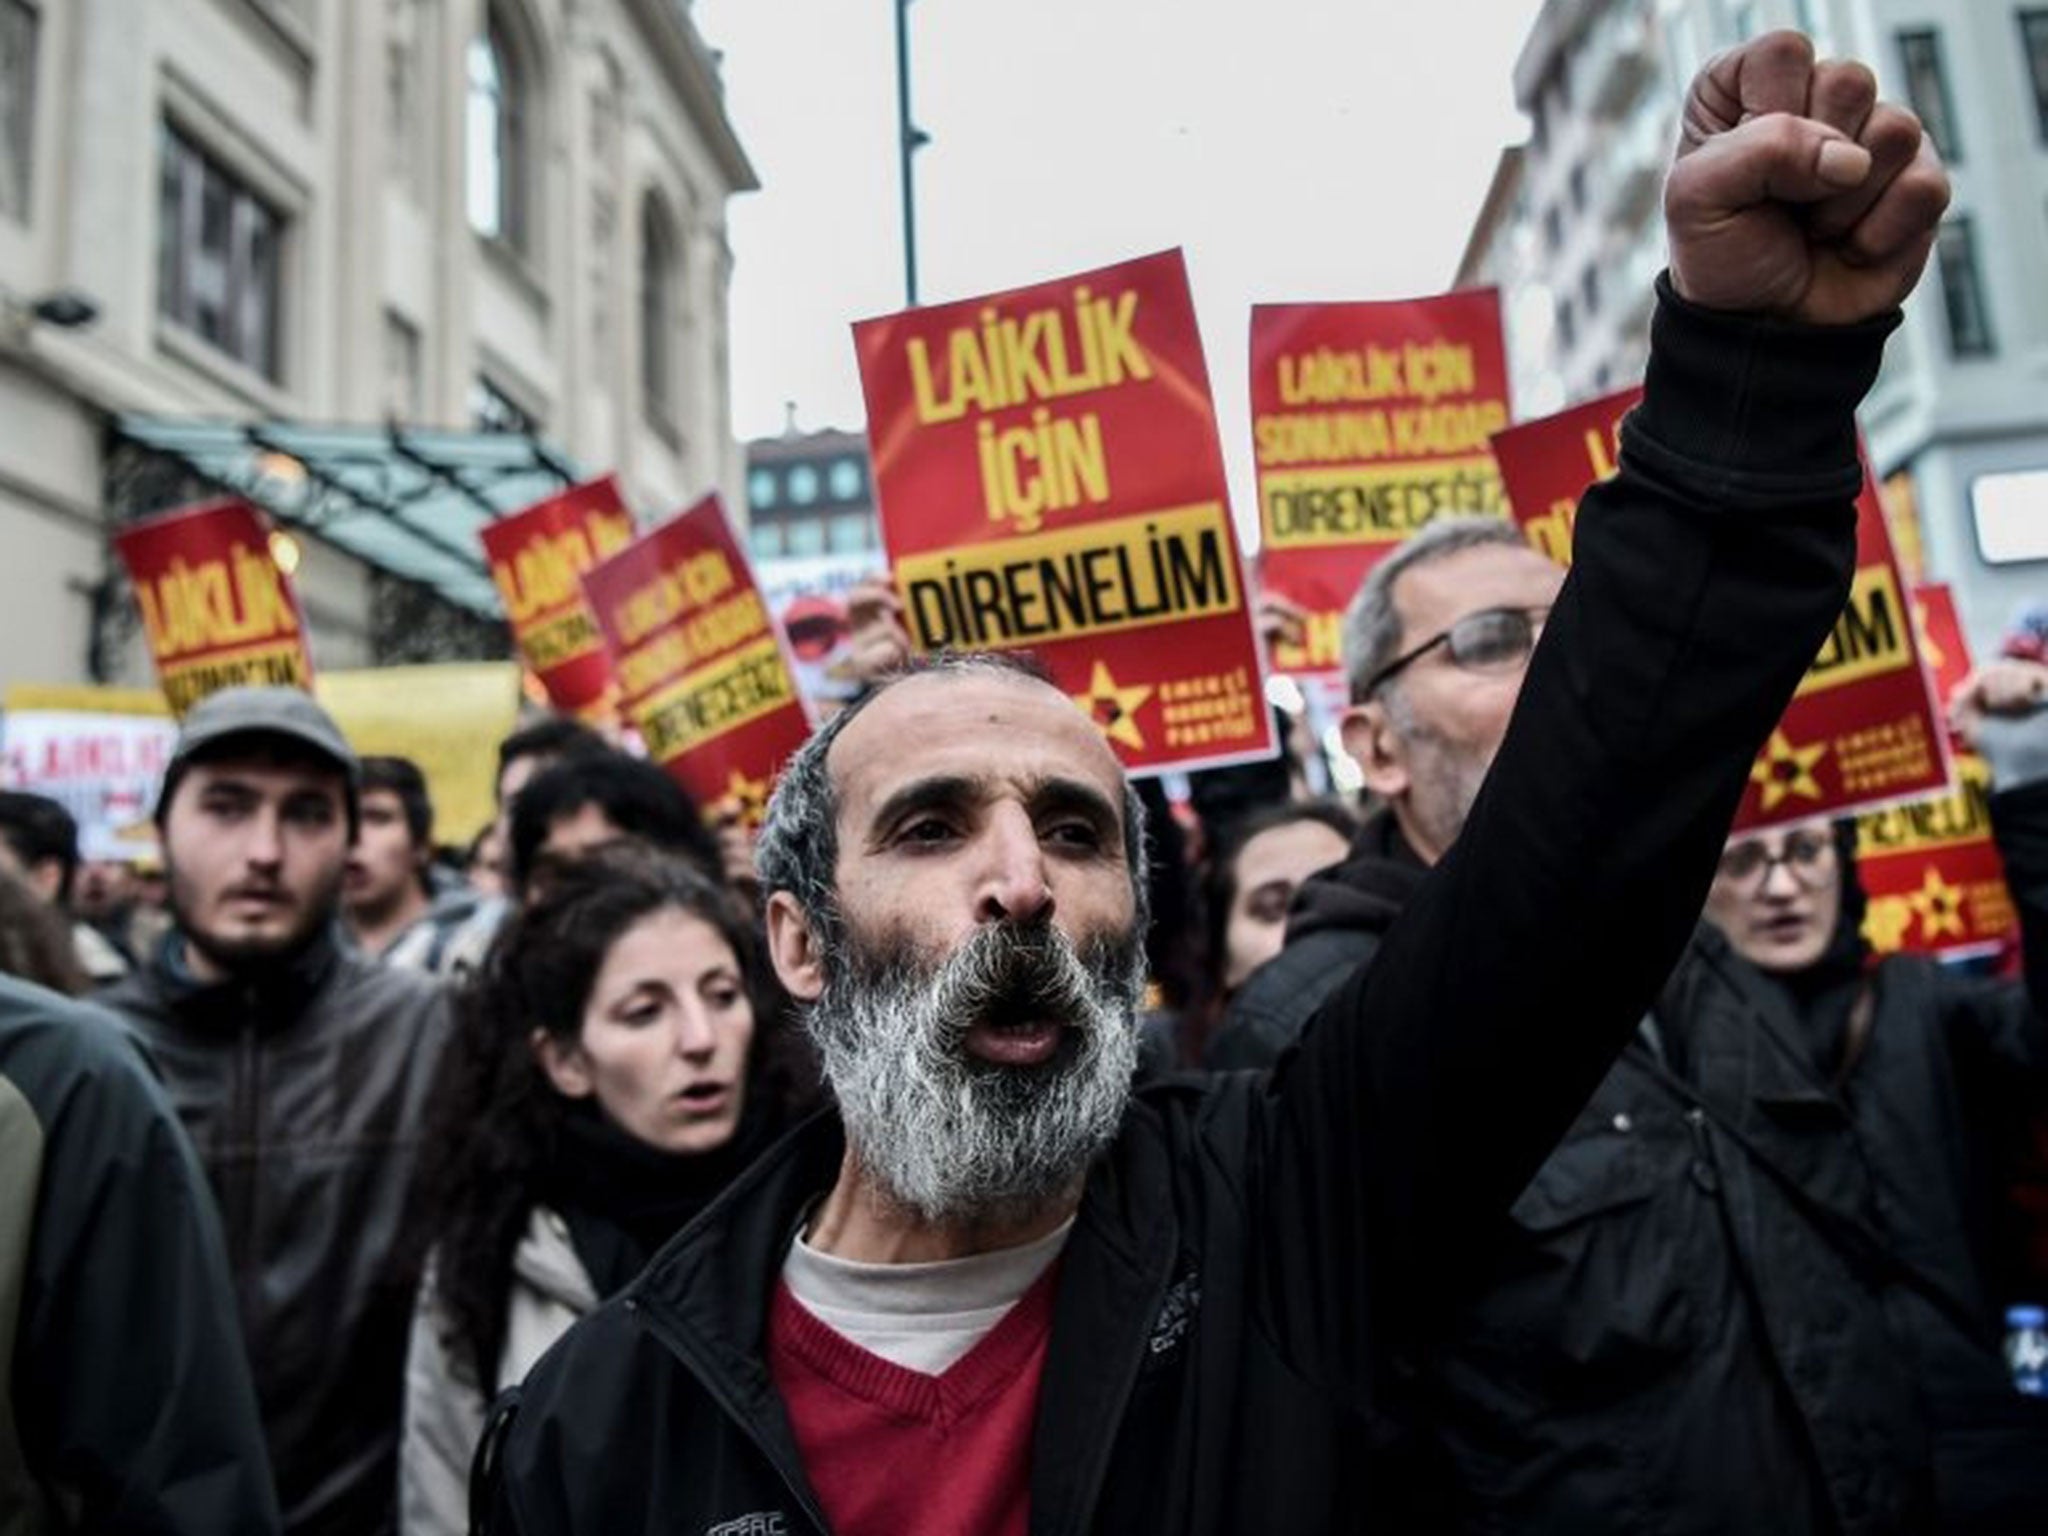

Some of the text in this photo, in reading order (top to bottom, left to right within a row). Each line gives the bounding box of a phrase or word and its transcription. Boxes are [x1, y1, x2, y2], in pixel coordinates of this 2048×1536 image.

[905, 285, 1152, 425] LAİKLİK
[976, 406, 1111, 534] İÇİN
[909, 523, 1229, 650] DİRENELİM
